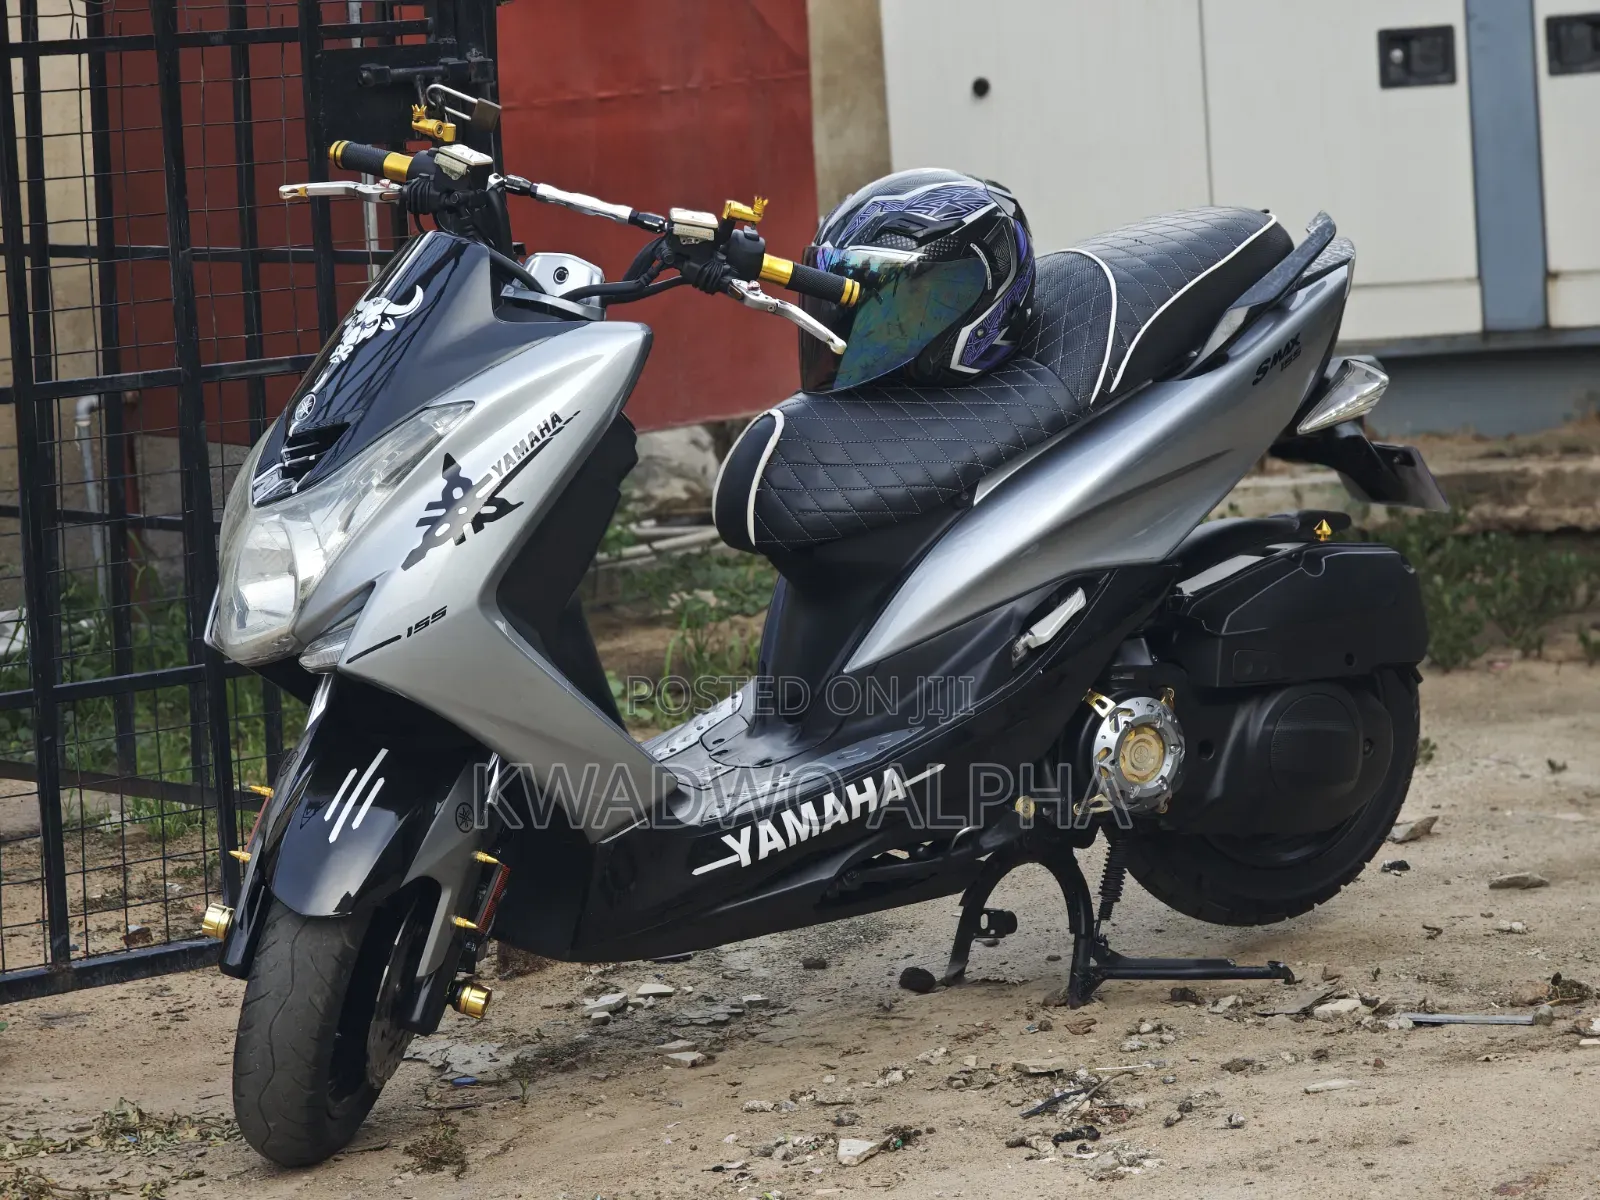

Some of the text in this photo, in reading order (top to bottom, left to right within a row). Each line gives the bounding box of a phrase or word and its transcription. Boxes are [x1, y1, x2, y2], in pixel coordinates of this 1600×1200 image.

[1252, 332, 1301, 386] SMAX
[491, 412, 563, 477] YAMAHA
[406, 605, 448, 638] 155
[720, 767, 906, 868] YAMAHA
